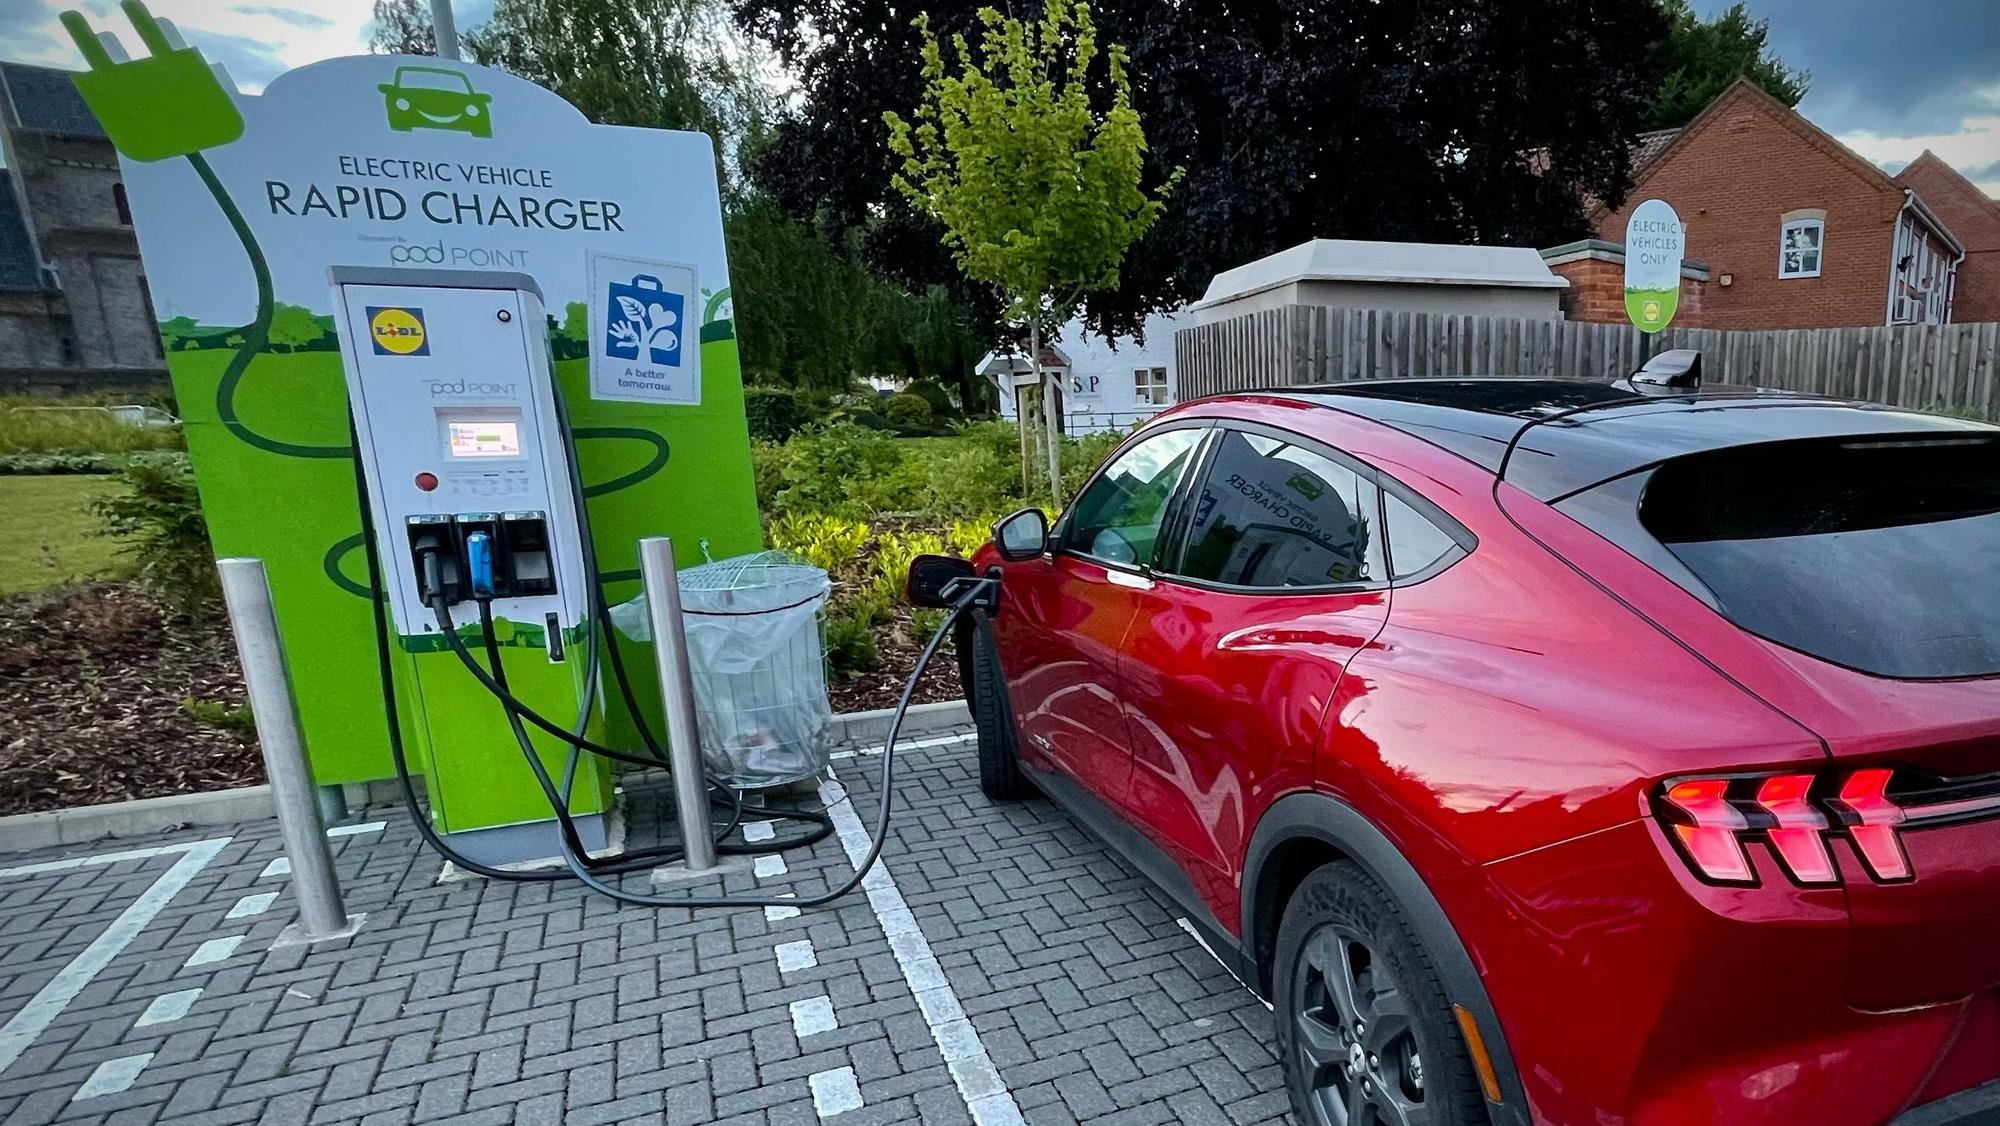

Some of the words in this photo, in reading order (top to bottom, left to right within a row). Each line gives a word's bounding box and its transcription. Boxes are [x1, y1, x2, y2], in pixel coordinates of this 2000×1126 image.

[339, 155, 452, 182] ELECTRIC
[457, 164, 553, 188] VEHICLE
[265, 181, 406, 221] RAPID
[421, 191, 625, 232] CHARGER
[1633, 220, 1677, 233] ELECTRIC
[1631, 237, 1677, 250] VEHICLES
[390, 239, 445, 266] pod
[451, 247, 529, 267] POINT
[1640, 253, 1667, 264] ONLY
[624, 368, 633, 376] A
[635, 369, 665, 379] better
[431, 378, 465, 398] pod
[468, 383, 518, 395] POINT
[486, 513, 494, 521] 2
